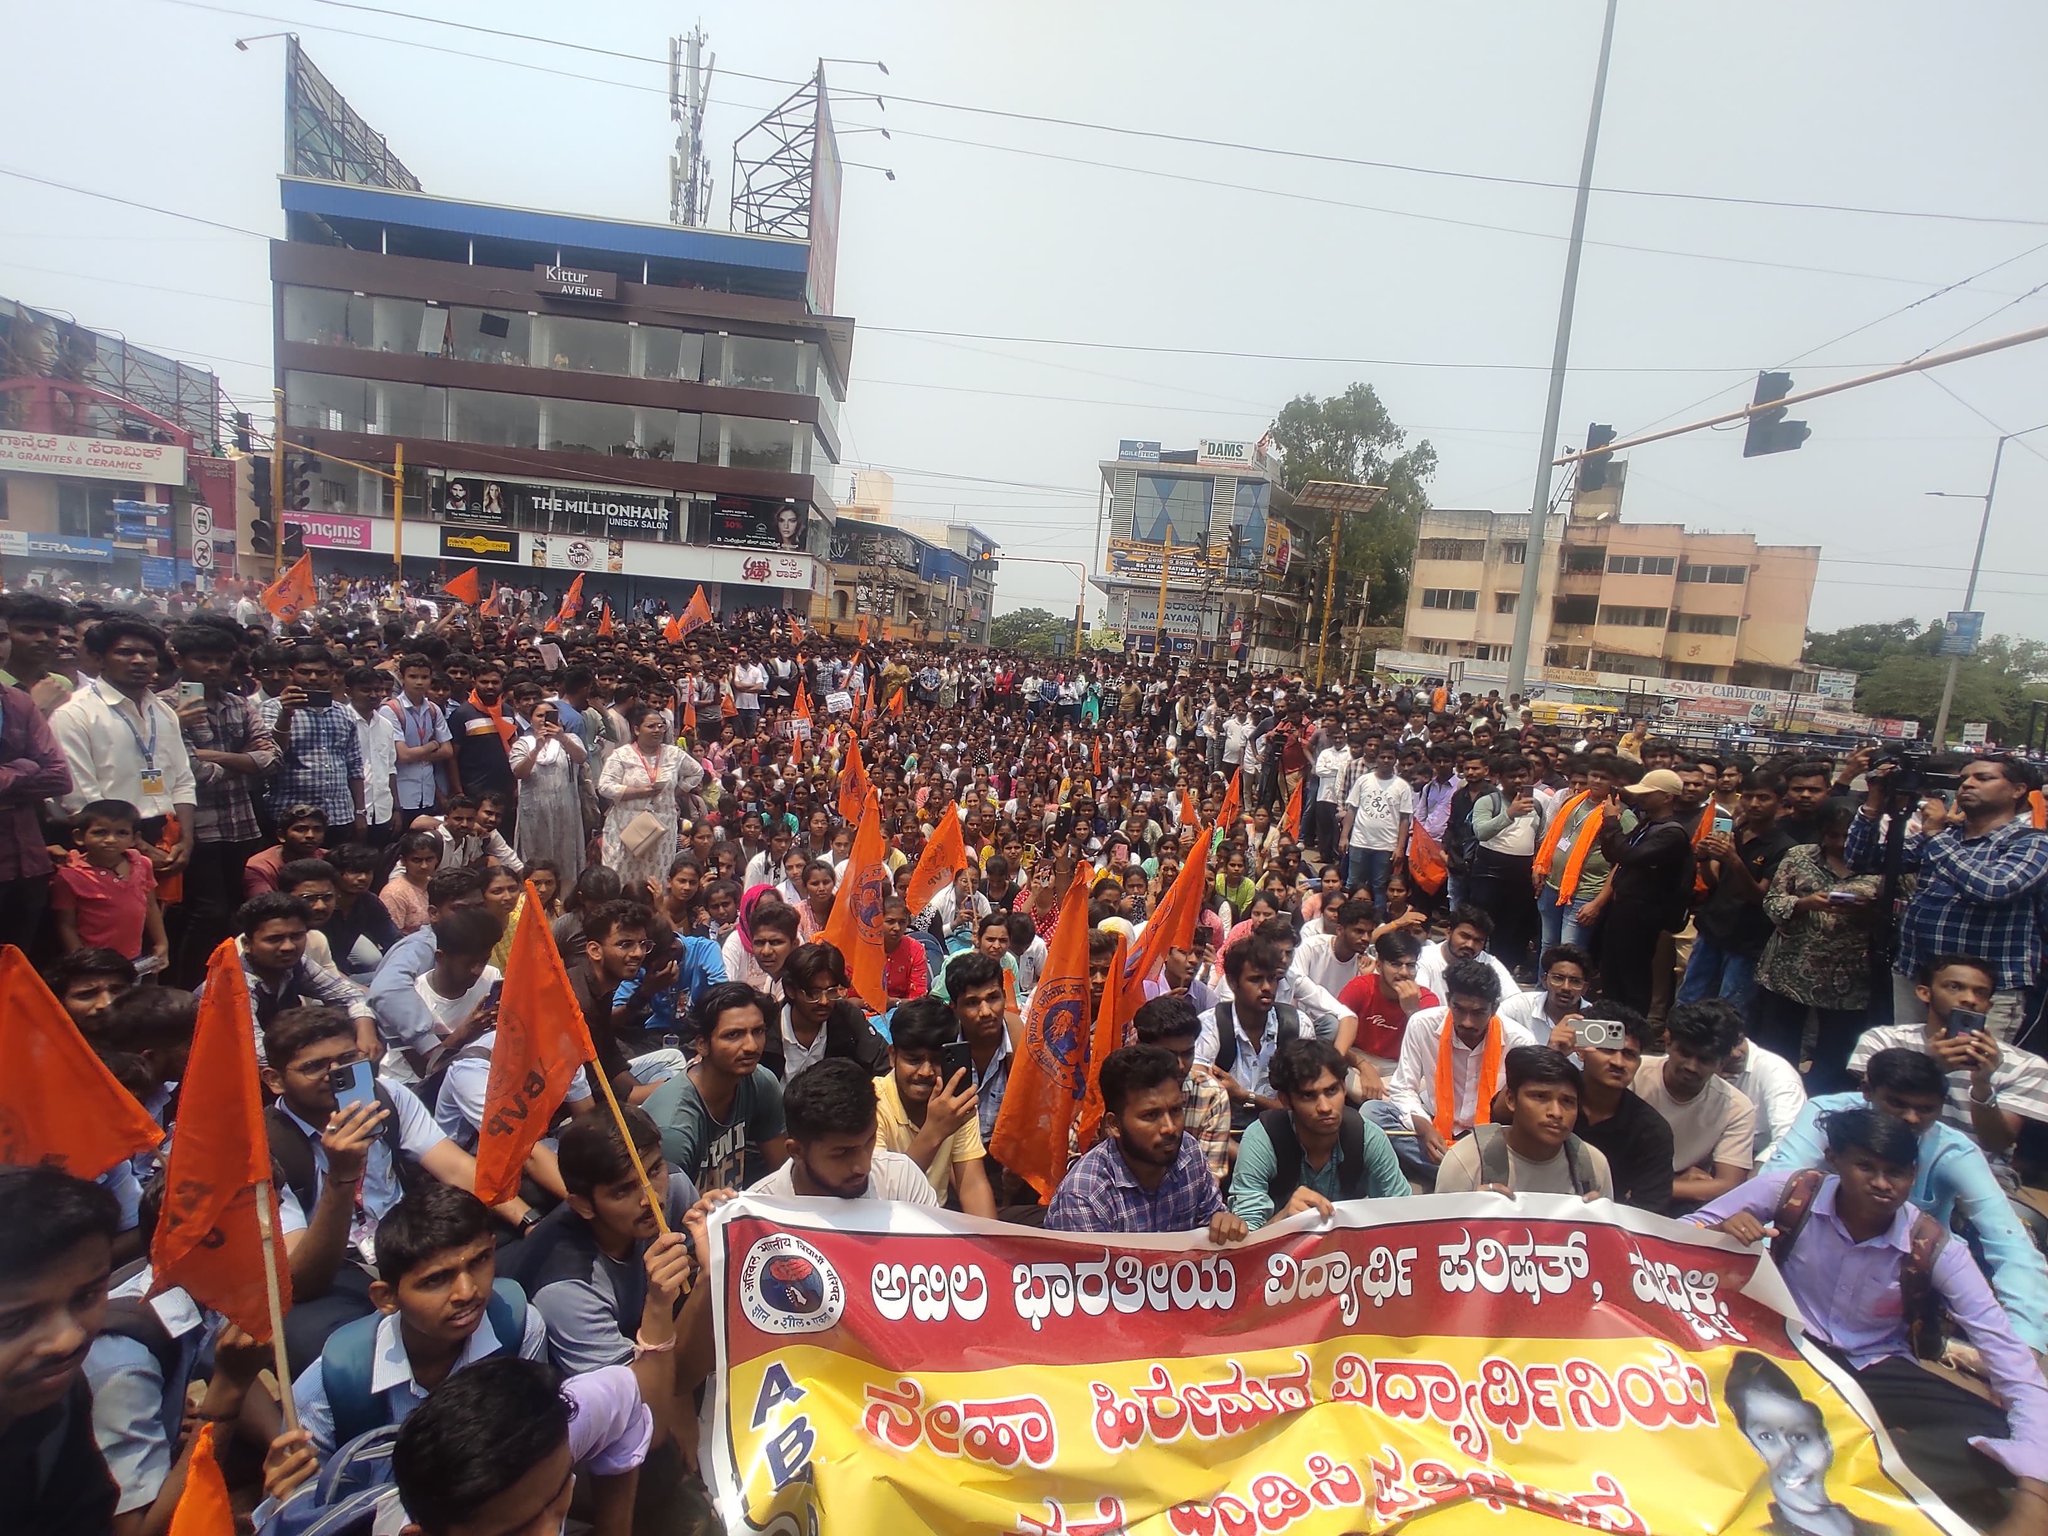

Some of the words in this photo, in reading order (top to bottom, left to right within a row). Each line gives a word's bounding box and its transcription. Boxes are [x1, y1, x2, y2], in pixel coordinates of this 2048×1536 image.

[546, 265, 589, 284] Kittur
[561, 285, 603, 297] AVENUE
[67, 441, 78, 452] &
[1207, 442, 1243, 457] DAMS
[17, 452, 73, 464] GRANITES
[75, 457, 82, 465] &
[86, 458, 144, 470] CERAMICS
[531, 496, 563, 512] THE
[565, 500, 669, 521] MILLIONHAIR
[609, 518, 639, 528] UNISEX
[641, 521, 669, 530] SALON
[29, 541, 72, 554] CERA
[1712, 685, 1734, 697] CAR
[1736, 687, 1771, 701] DECOR
[1365, 807, 1391, 819] UNION
[871, 1261, 989, 1322] ಅಖಿಲ
[1012, 1248, 1237, 1332] ಭಾರತೀಯ
[1265, 1245, 1417, 1327] ವಿದ್ಯಾರ್ಥಿ
[752, 1304, 771, 1324] ज्ञान
[780, 1315, 804, 1329] शील
[864, 1377, 1057, 1468] ನೇಹಾ
[1091, 1353, 1312, 1452] ಹಿರೇಮಠ
[1331, 1345, 1718, 1464] ವಿದ್ಯಾರ್ಥಿನಿಯ
